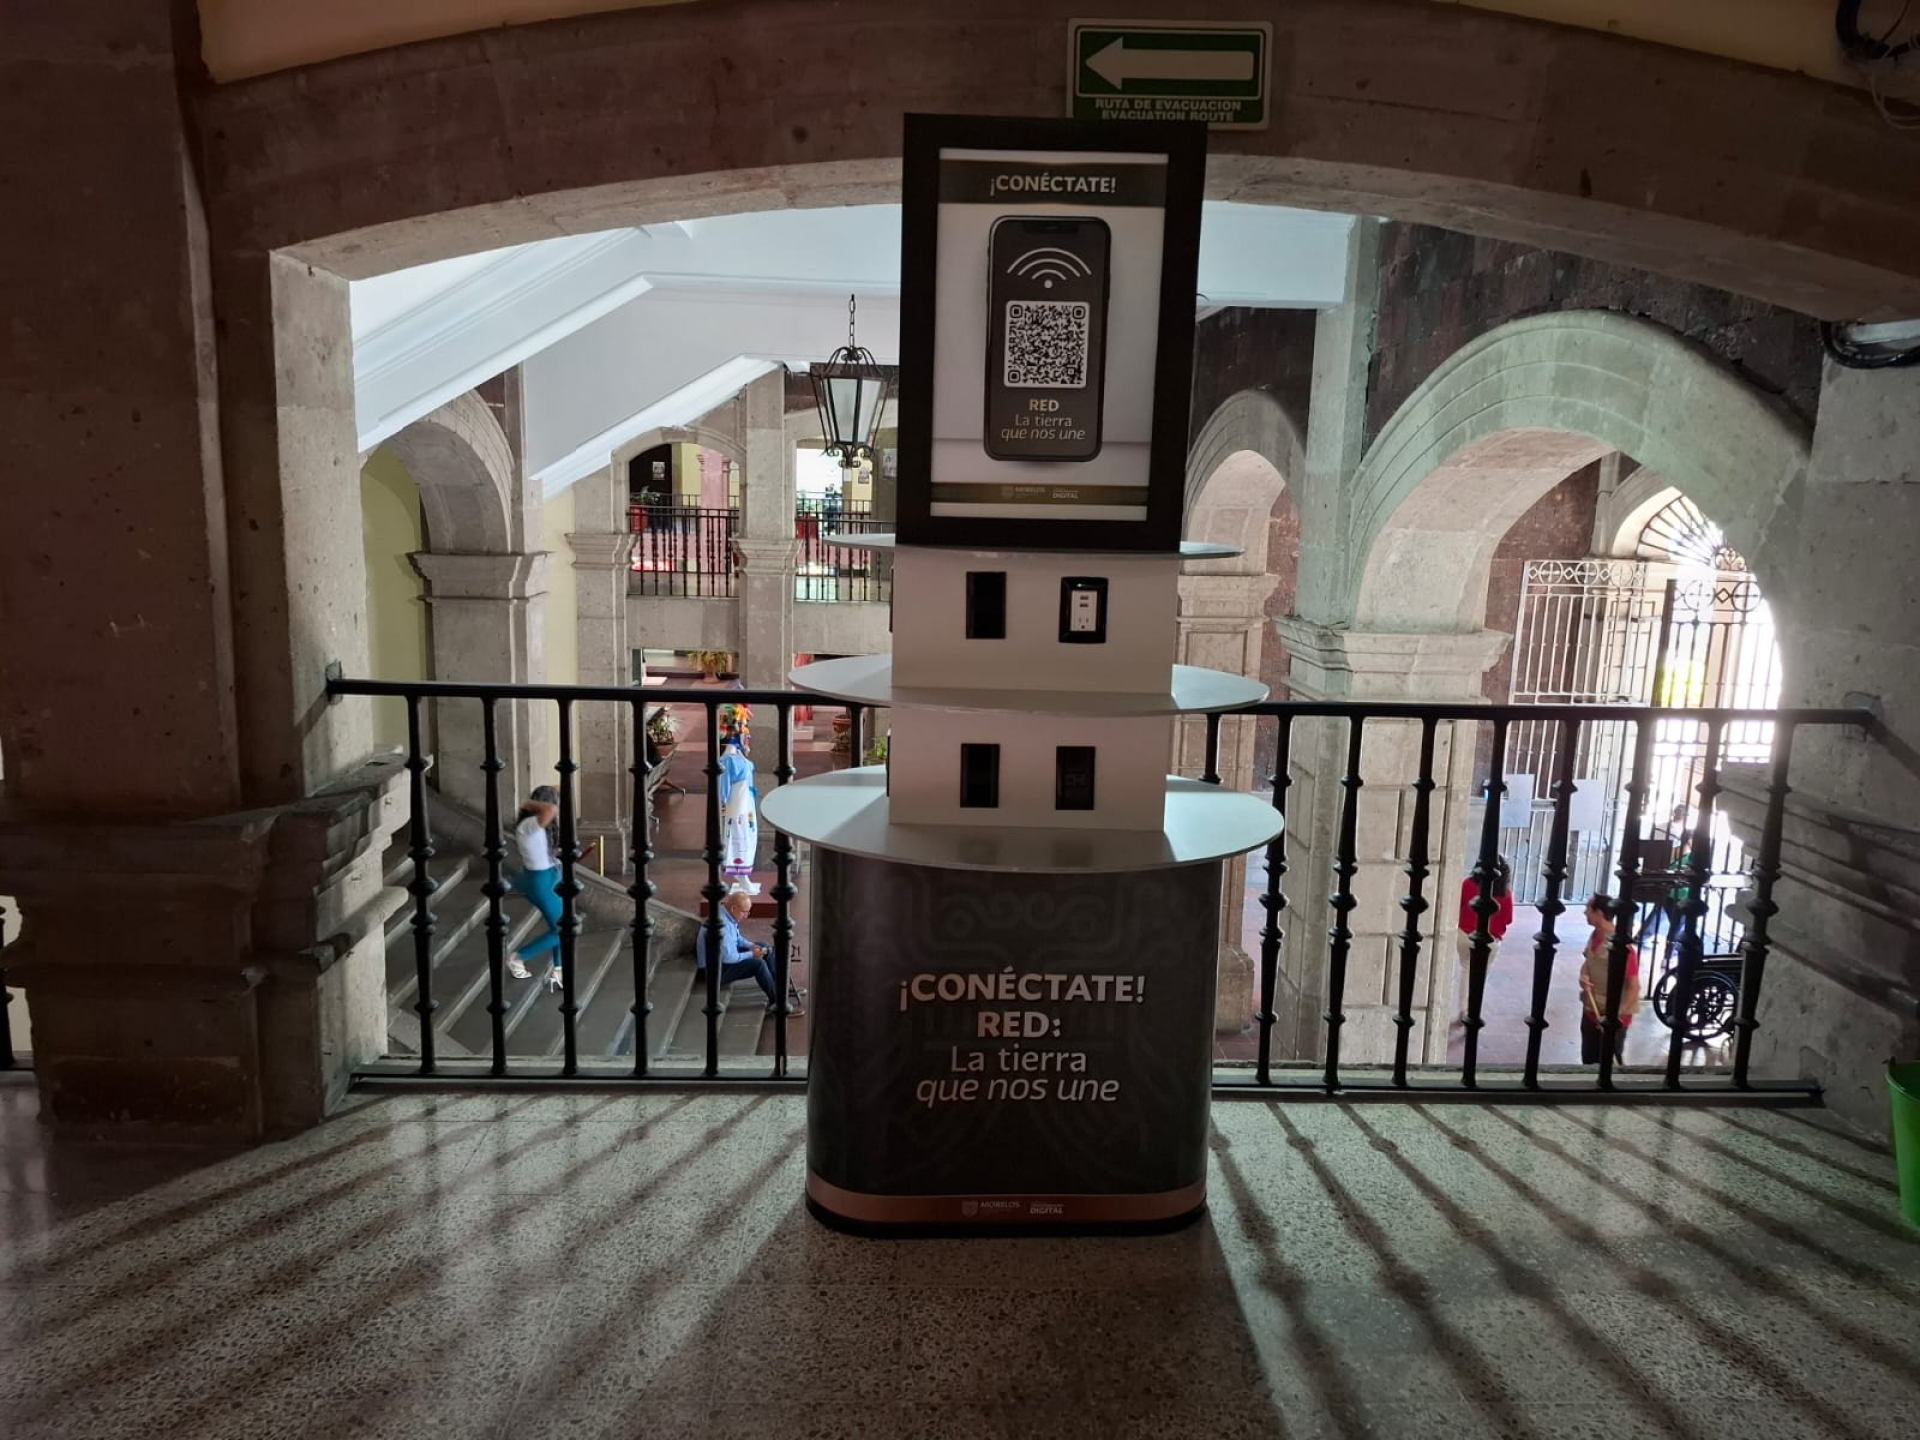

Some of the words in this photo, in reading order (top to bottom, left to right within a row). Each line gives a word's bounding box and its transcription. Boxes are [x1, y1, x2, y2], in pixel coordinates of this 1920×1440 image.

[1095, 98, 1130, 109] RUTA
[1134, 99, 1152, 110] DE
[1102, 110, 1185, 121] EVACUATION
[1190, 111, 1234, 122] ROUTE
[989, 172, 1117, 196] ¡CONÉCTATE!
[1029, 398, 1060, 412] RED
[1014, 413, 1030, 427] La
[1034, 413, 1073, 428] tierra
[1001, 428, 1028, 442] que
[1030, 428, 1057, 440] nos
[1059, 428, 1086, 441] une
[900, 965, 1146, 1011] ¡CONÉCTATE!
[977, 1011, 1062, 1038] RED:
[950, 1045, 985, 1073] La
[998, 1043, 1087, 1073] tierra
[916, 1078, 978, 1108] que
[988, 1077, 1049, 1101] nos
[1057, 1078, 1120, 1102] une
[1030, 1207, 1064, 1215] DIGITAL
